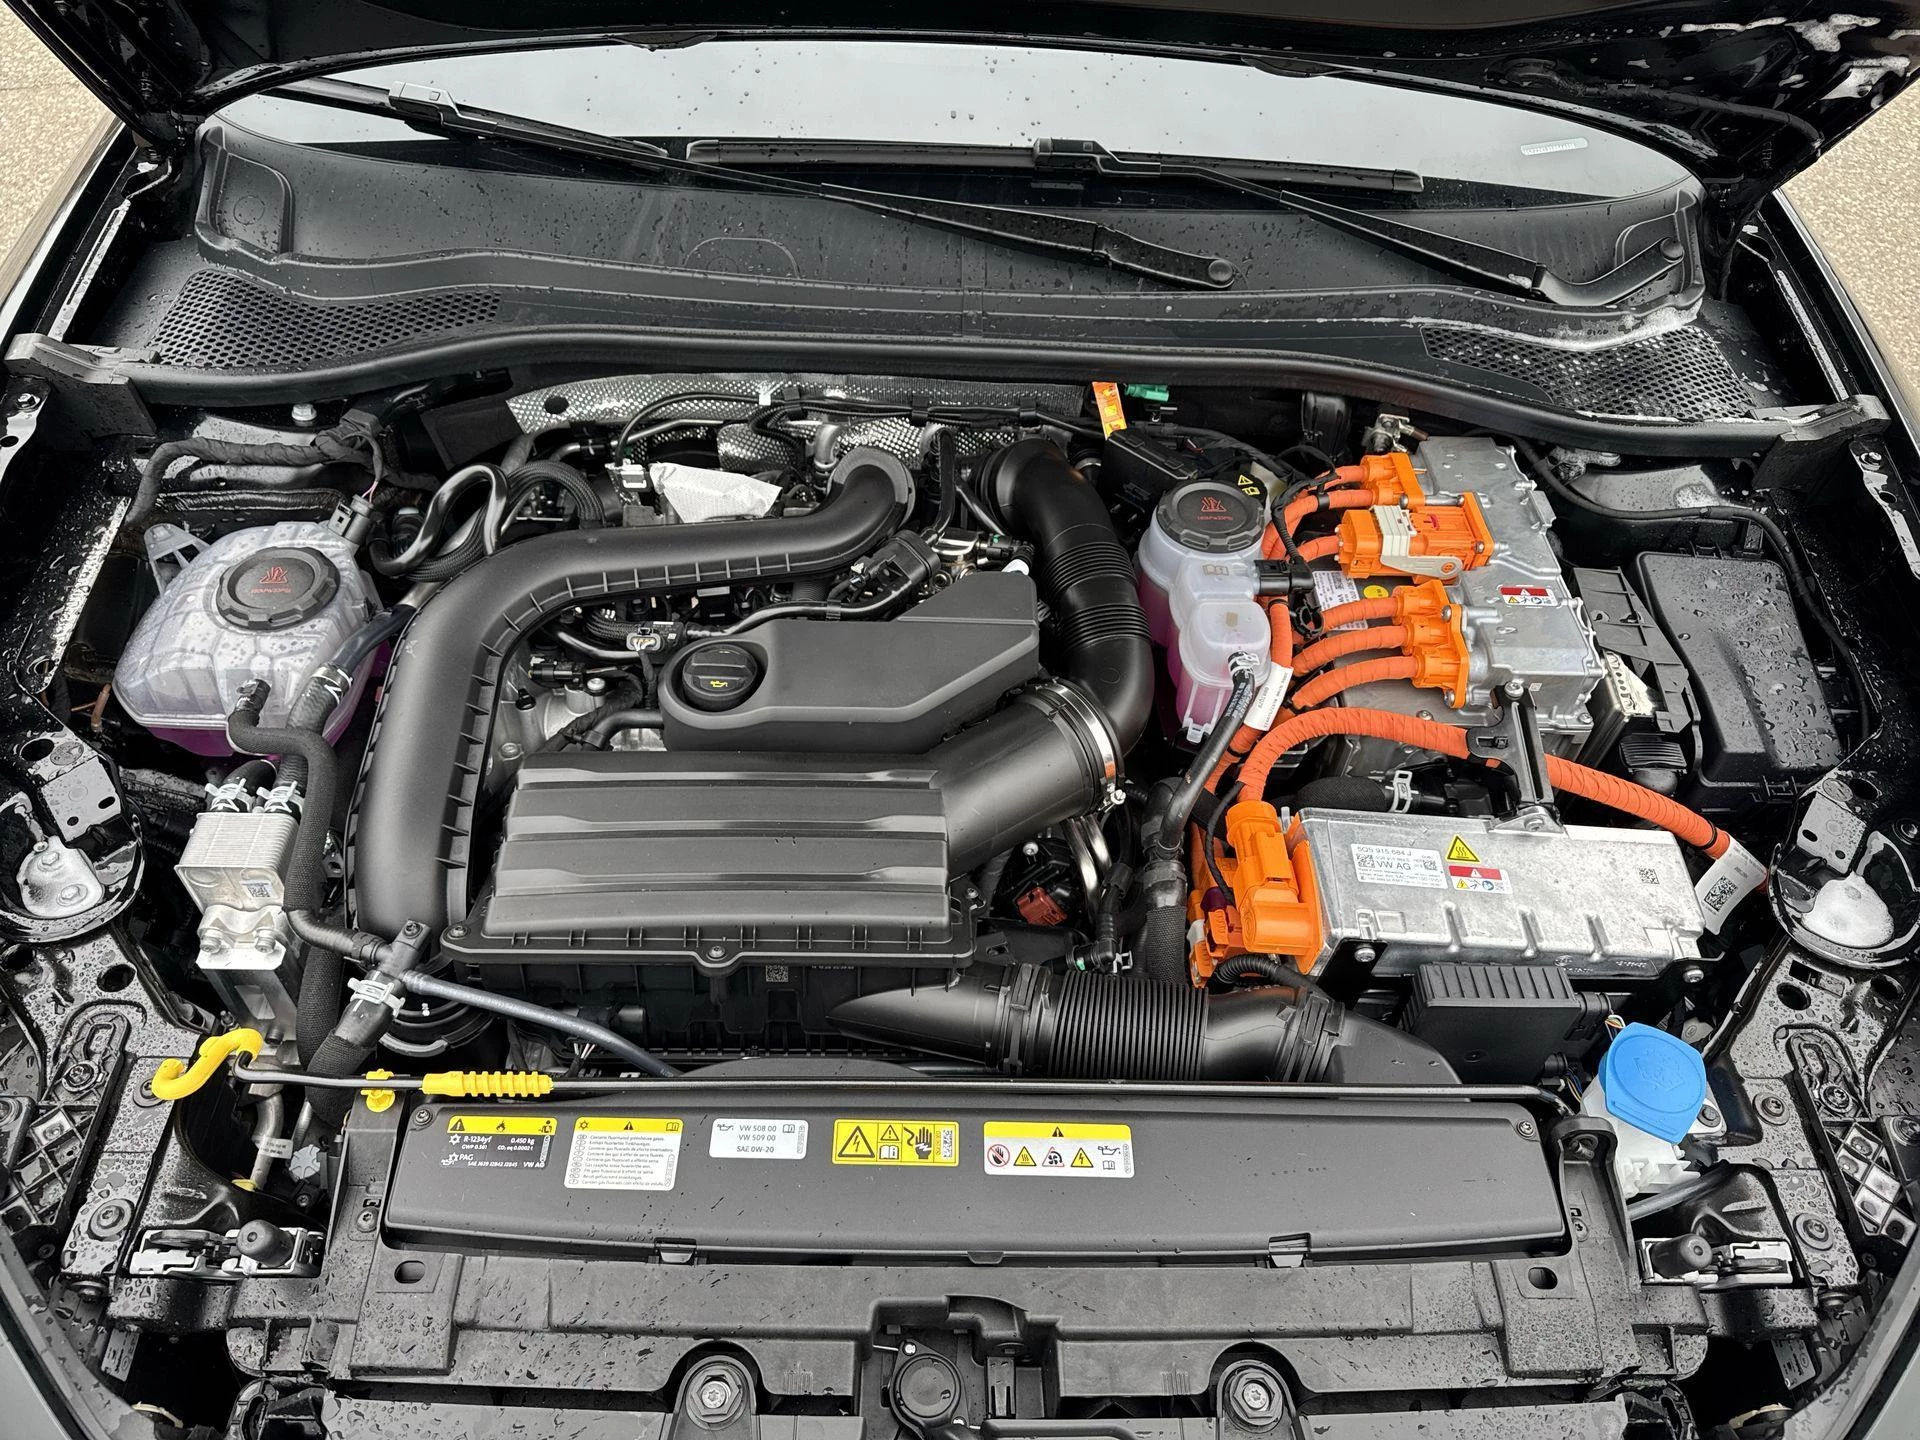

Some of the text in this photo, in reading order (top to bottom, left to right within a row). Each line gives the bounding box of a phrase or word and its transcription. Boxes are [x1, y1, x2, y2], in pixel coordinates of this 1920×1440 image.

[1376, 860, 1412, 870] VW AG
[463, 1135, 492, 1144] R-1234yf
[527, 1137, 535, 1146] kg
[736, 1145, 775, 1153] SAE 0W-20
[459, 1153, 474, 1161] PAG
